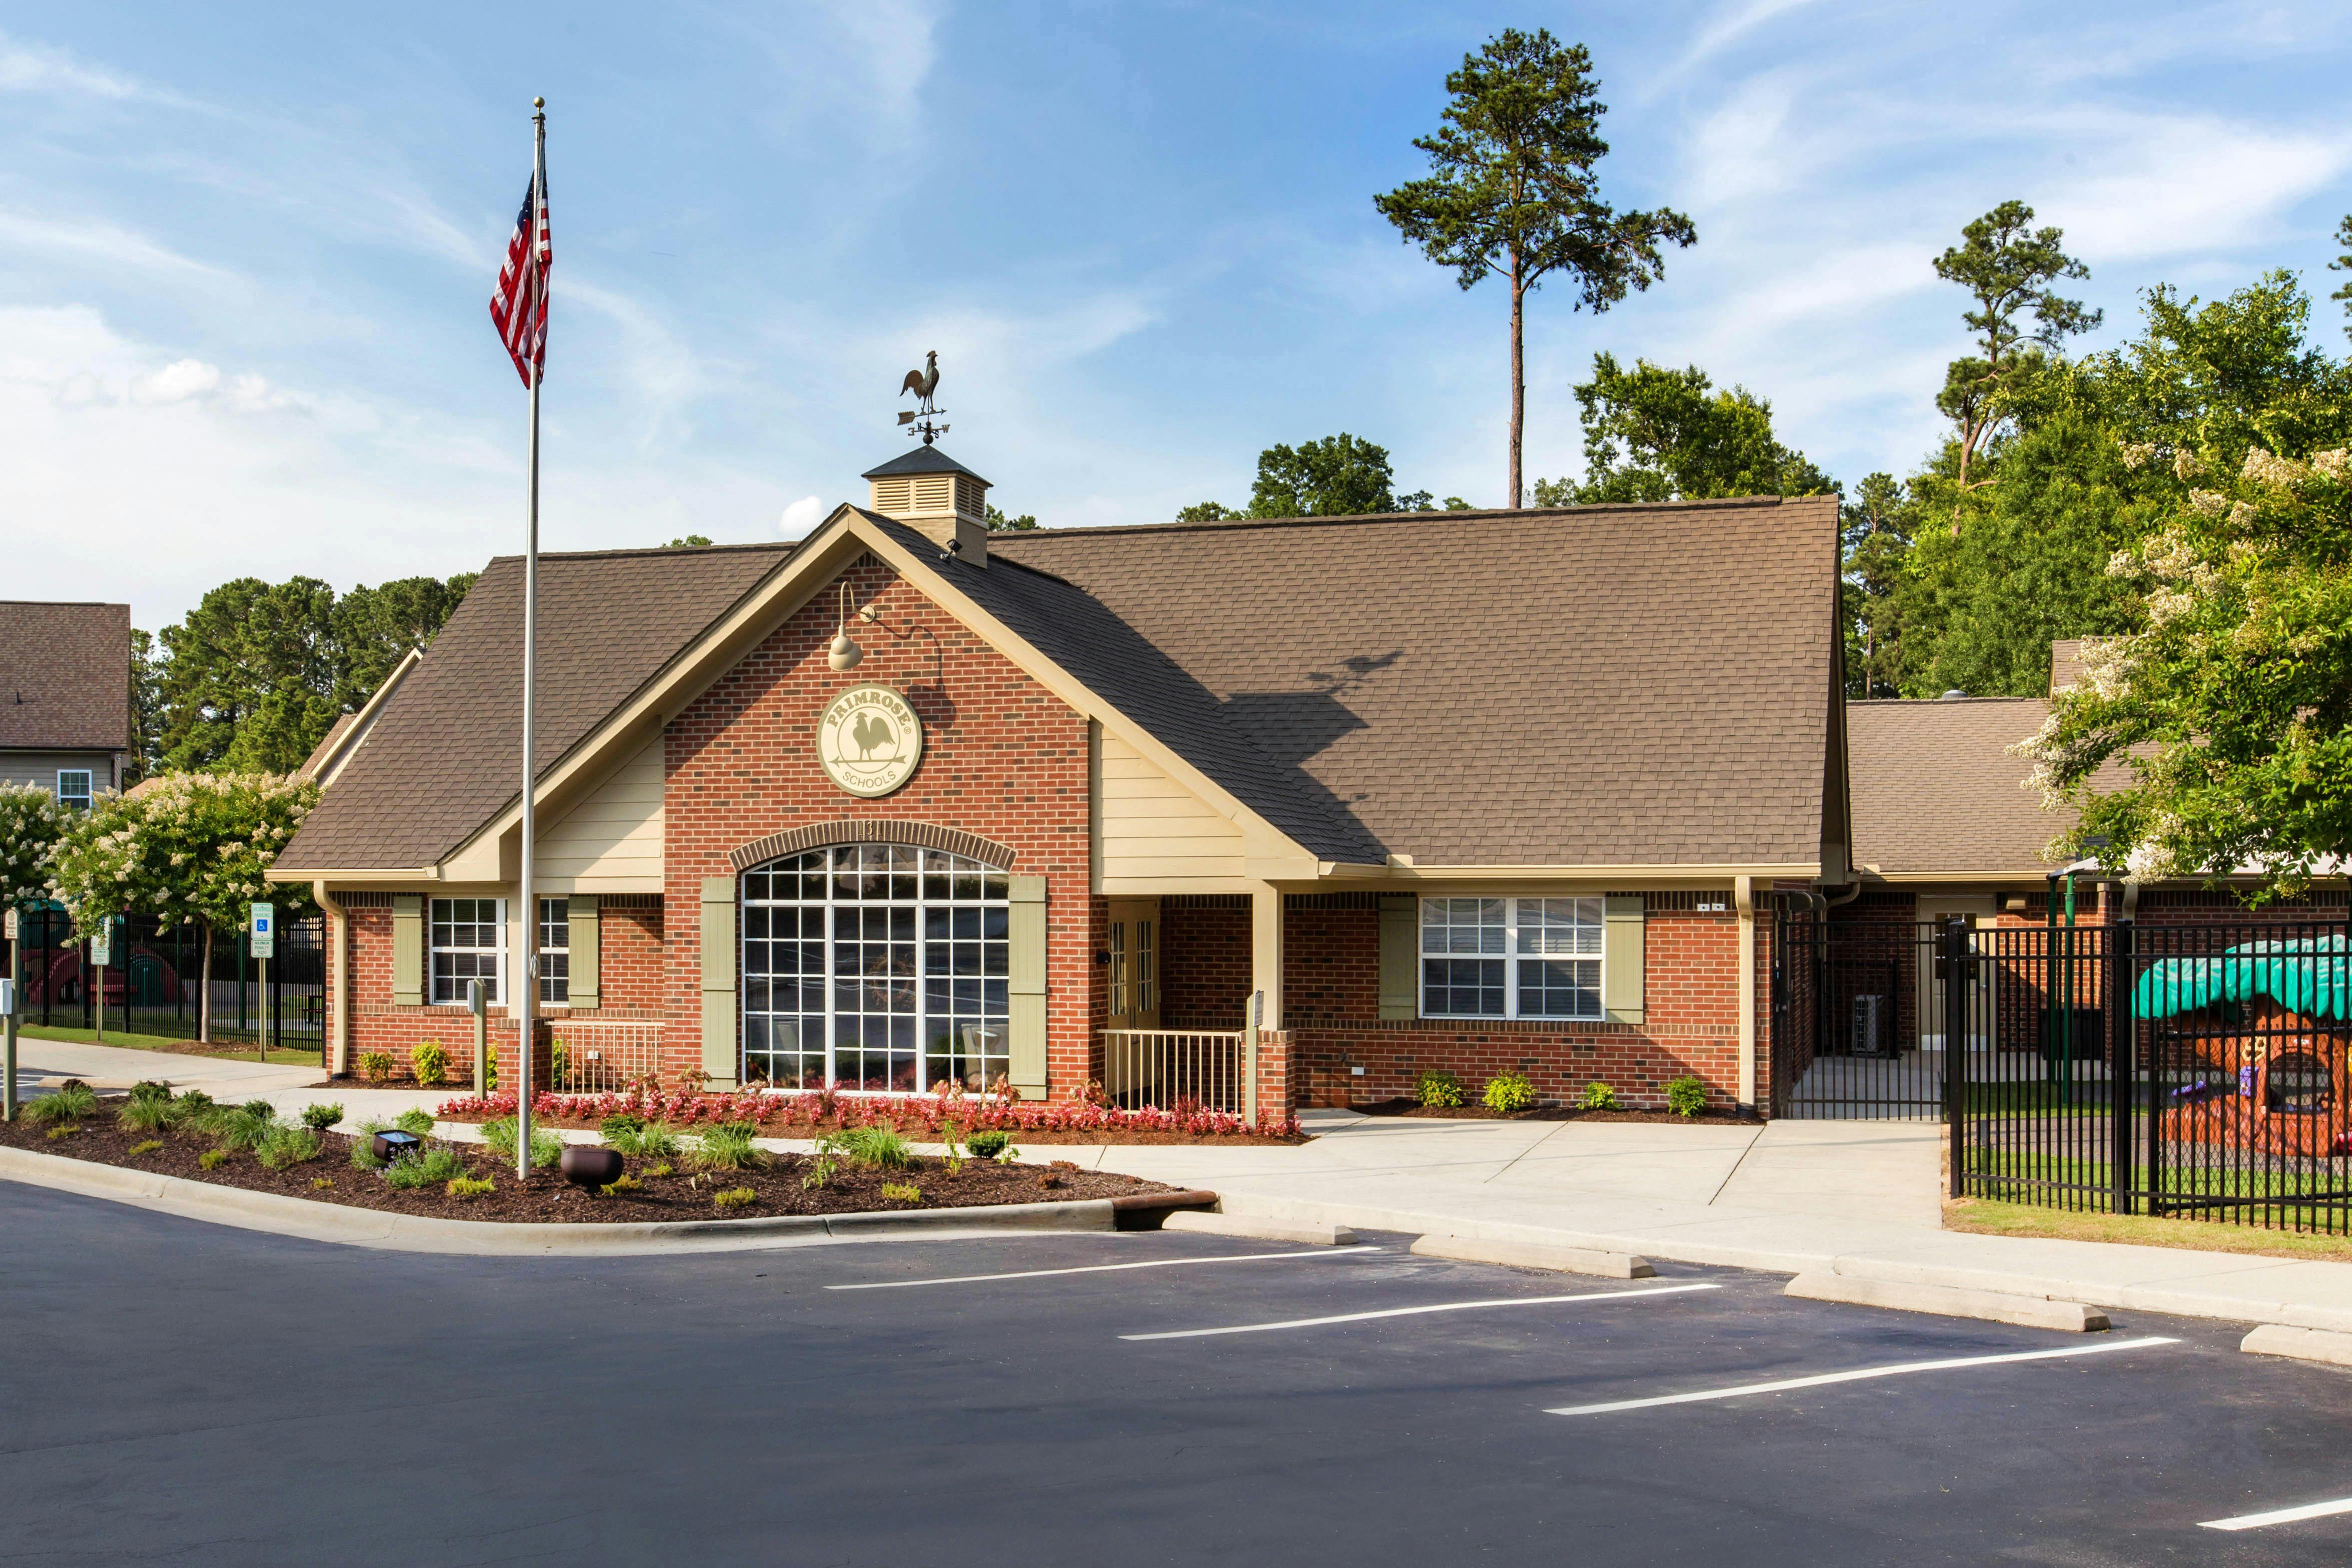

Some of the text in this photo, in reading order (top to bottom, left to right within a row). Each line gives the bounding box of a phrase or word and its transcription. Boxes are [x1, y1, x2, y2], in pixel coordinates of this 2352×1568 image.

[941, 424, 950, 433] W
[842, 770, 896, 788] SCHOOLS
[858, 822, 884, 836] 131
